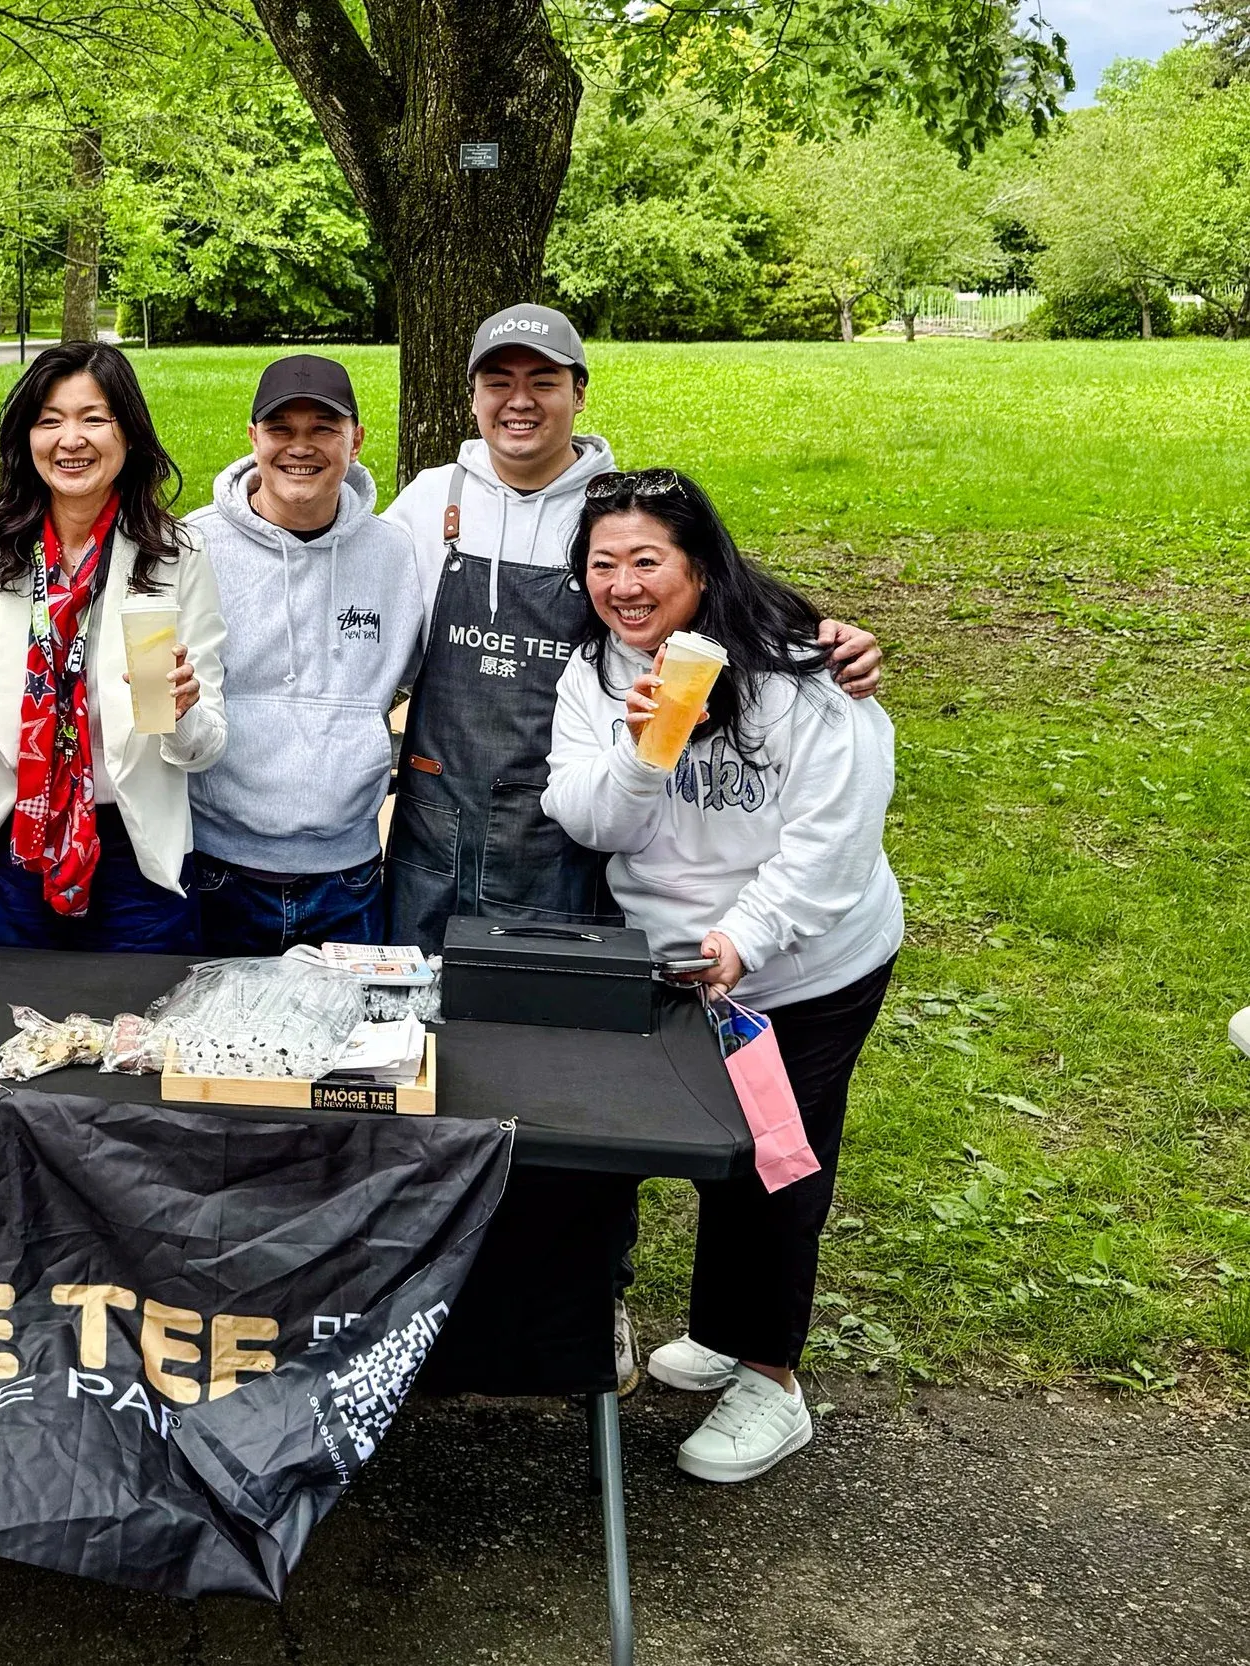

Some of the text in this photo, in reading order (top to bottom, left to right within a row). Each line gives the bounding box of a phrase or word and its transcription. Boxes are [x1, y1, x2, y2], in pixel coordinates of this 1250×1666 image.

[448, 624, 571, 660] MÖGE TEE
[323, 1087, 394, 1104] MÖGE TEE
[345, 1102, 369, 1110] HYDE
[370, 1103, 394, 1111] PARK
[51, 1284, 279, 1404] TEE
[67, 1367, 170, 1441] PA
